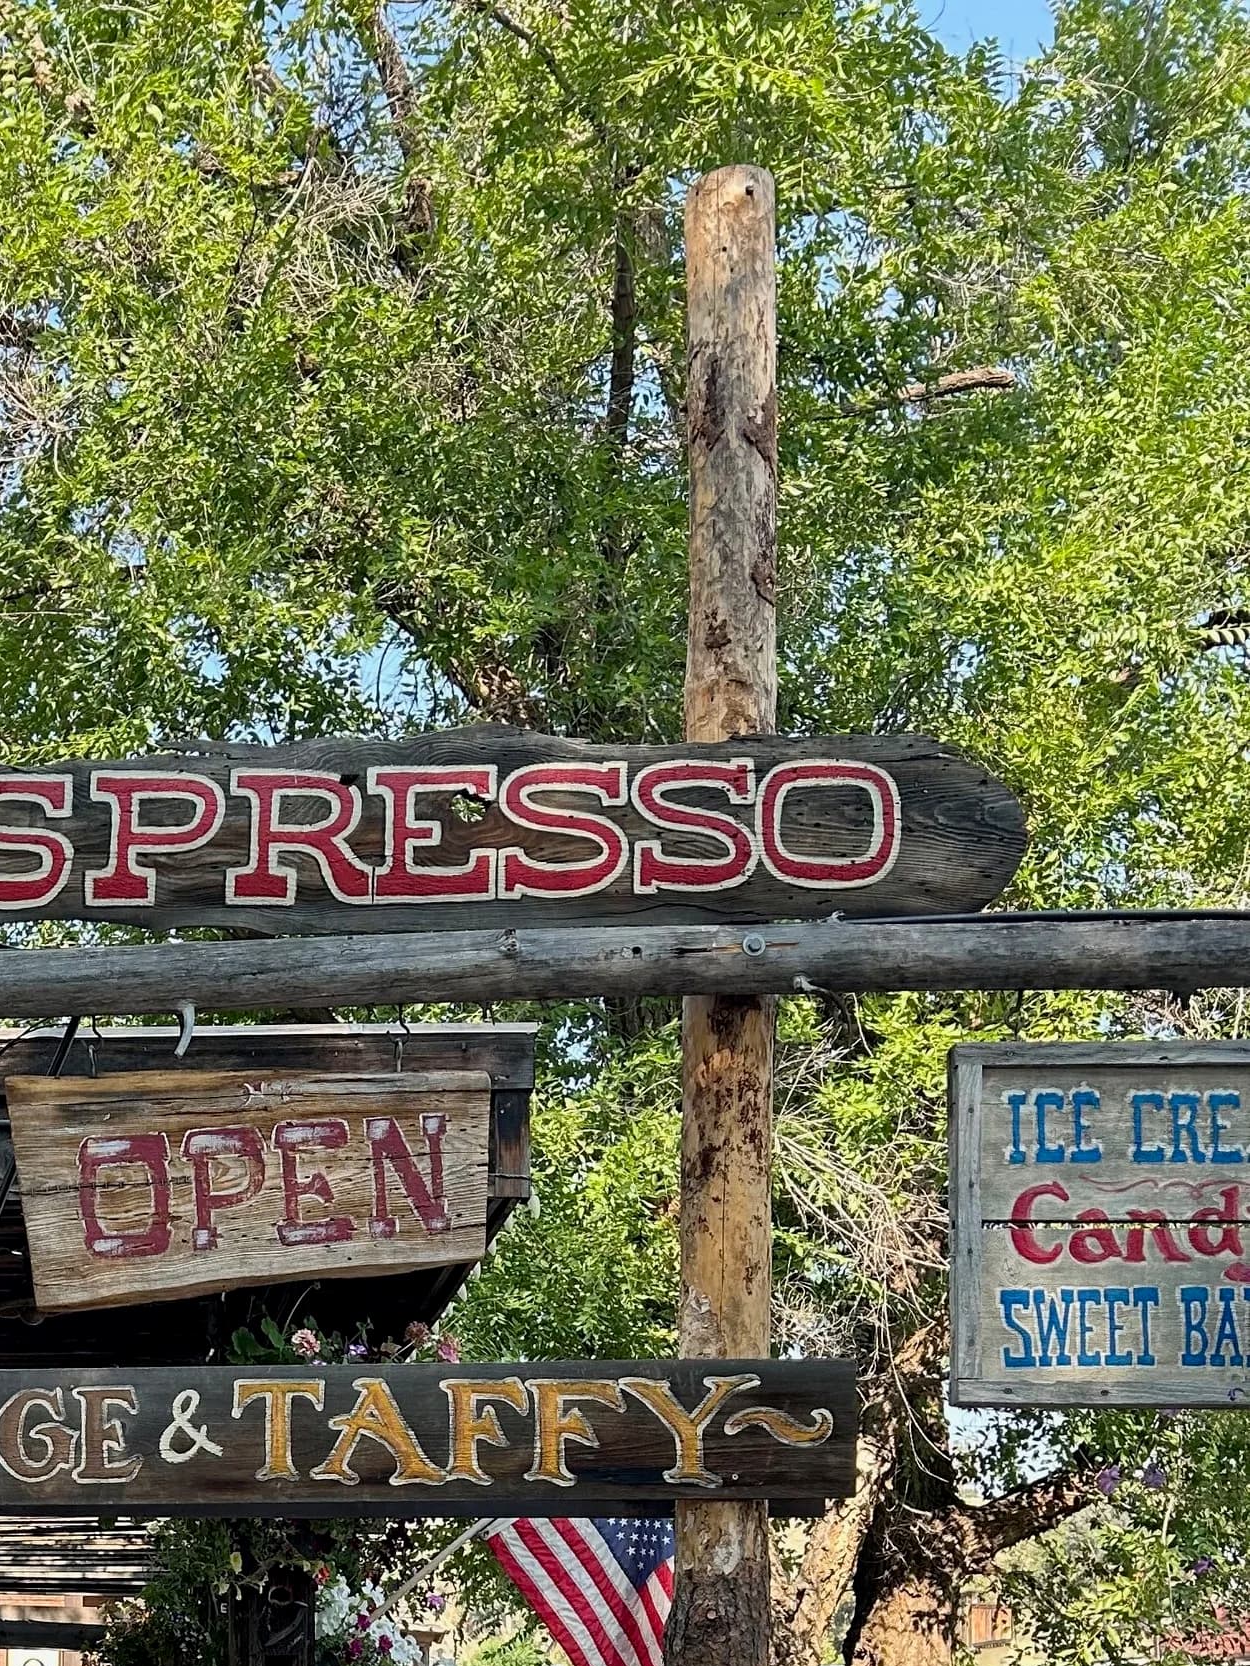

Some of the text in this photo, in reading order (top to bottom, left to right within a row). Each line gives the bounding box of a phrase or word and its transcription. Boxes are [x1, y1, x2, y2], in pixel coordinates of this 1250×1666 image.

[1002, 1088, 1250, 1165] ICE CRE
[76, 1112, 449, 1259] OPEN
[1010, 1181, 1250, 1283] Cand
[999, 1284, 1250, 1368] SWEET BA
[158, 1388, 225, 1465] &
[231, 1373, 762, 1488] TAFFY
